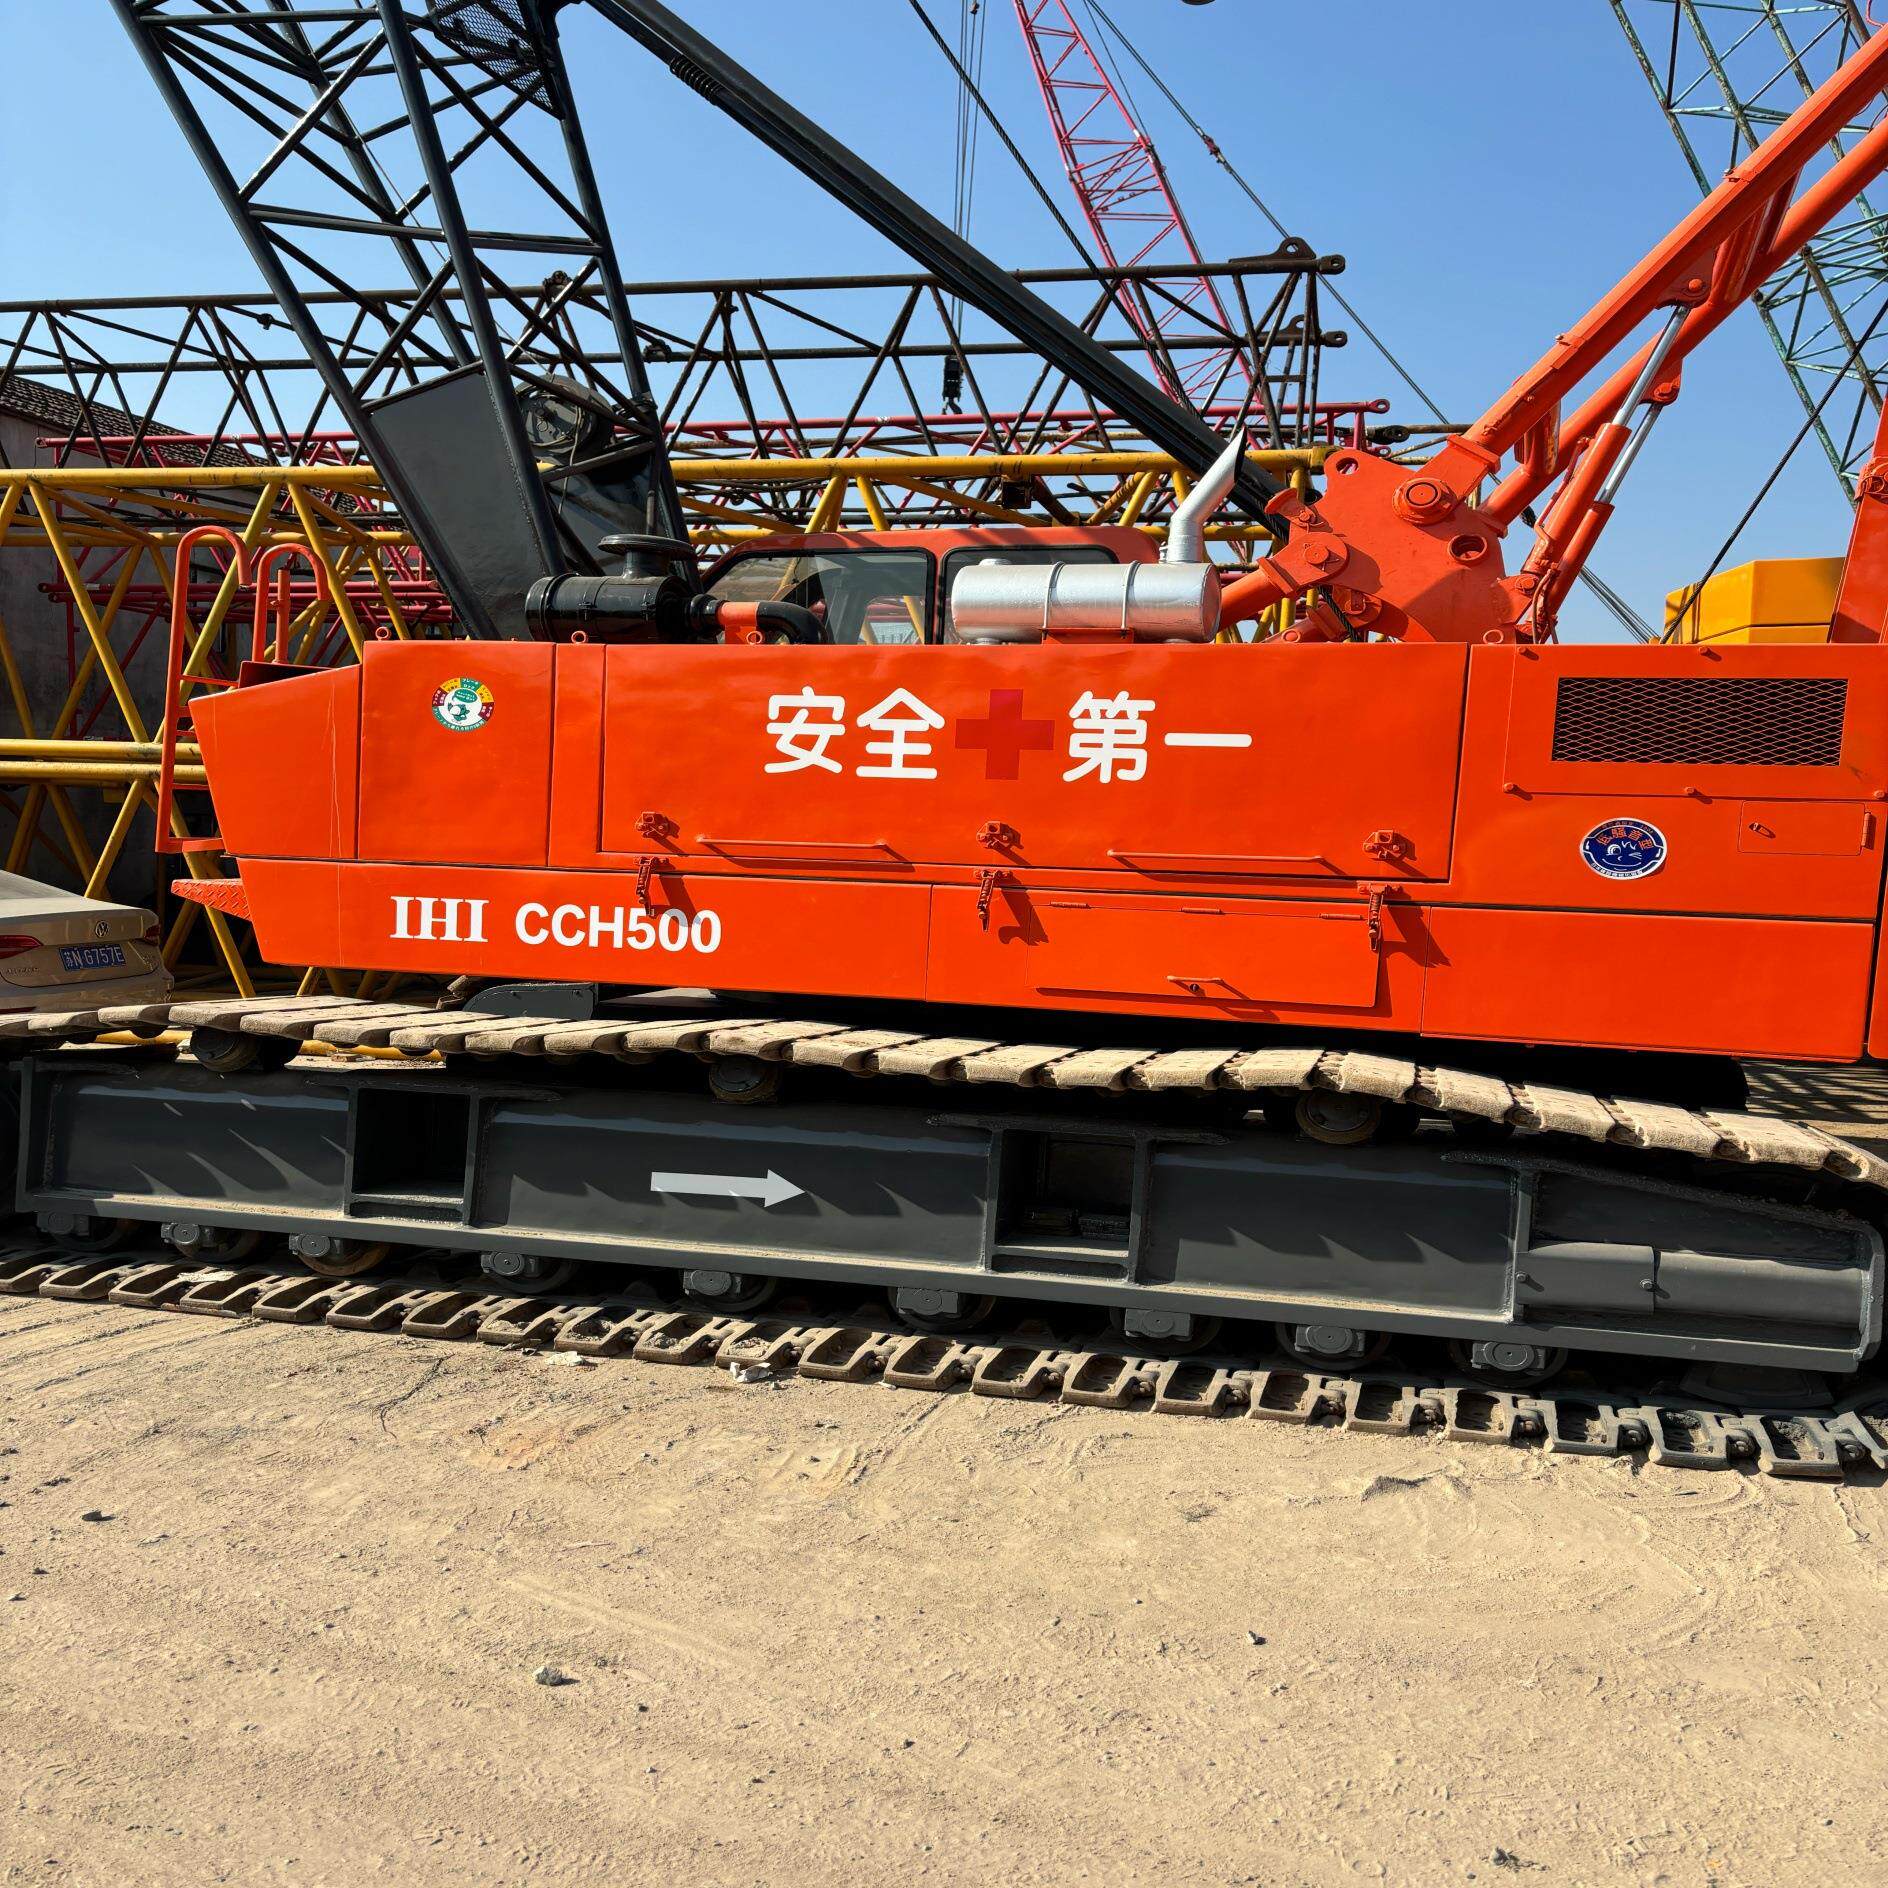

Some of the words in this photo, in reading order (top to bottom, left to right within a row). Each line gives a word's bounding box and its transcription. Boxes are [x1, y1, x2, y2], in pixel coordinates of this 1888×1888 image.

[764, 685, 946, 780] 安全
[1062, 690, 1253, 784] 第一
[389, 896, 490, 942] IHI
[515, 896, 722, 954] CCH500
